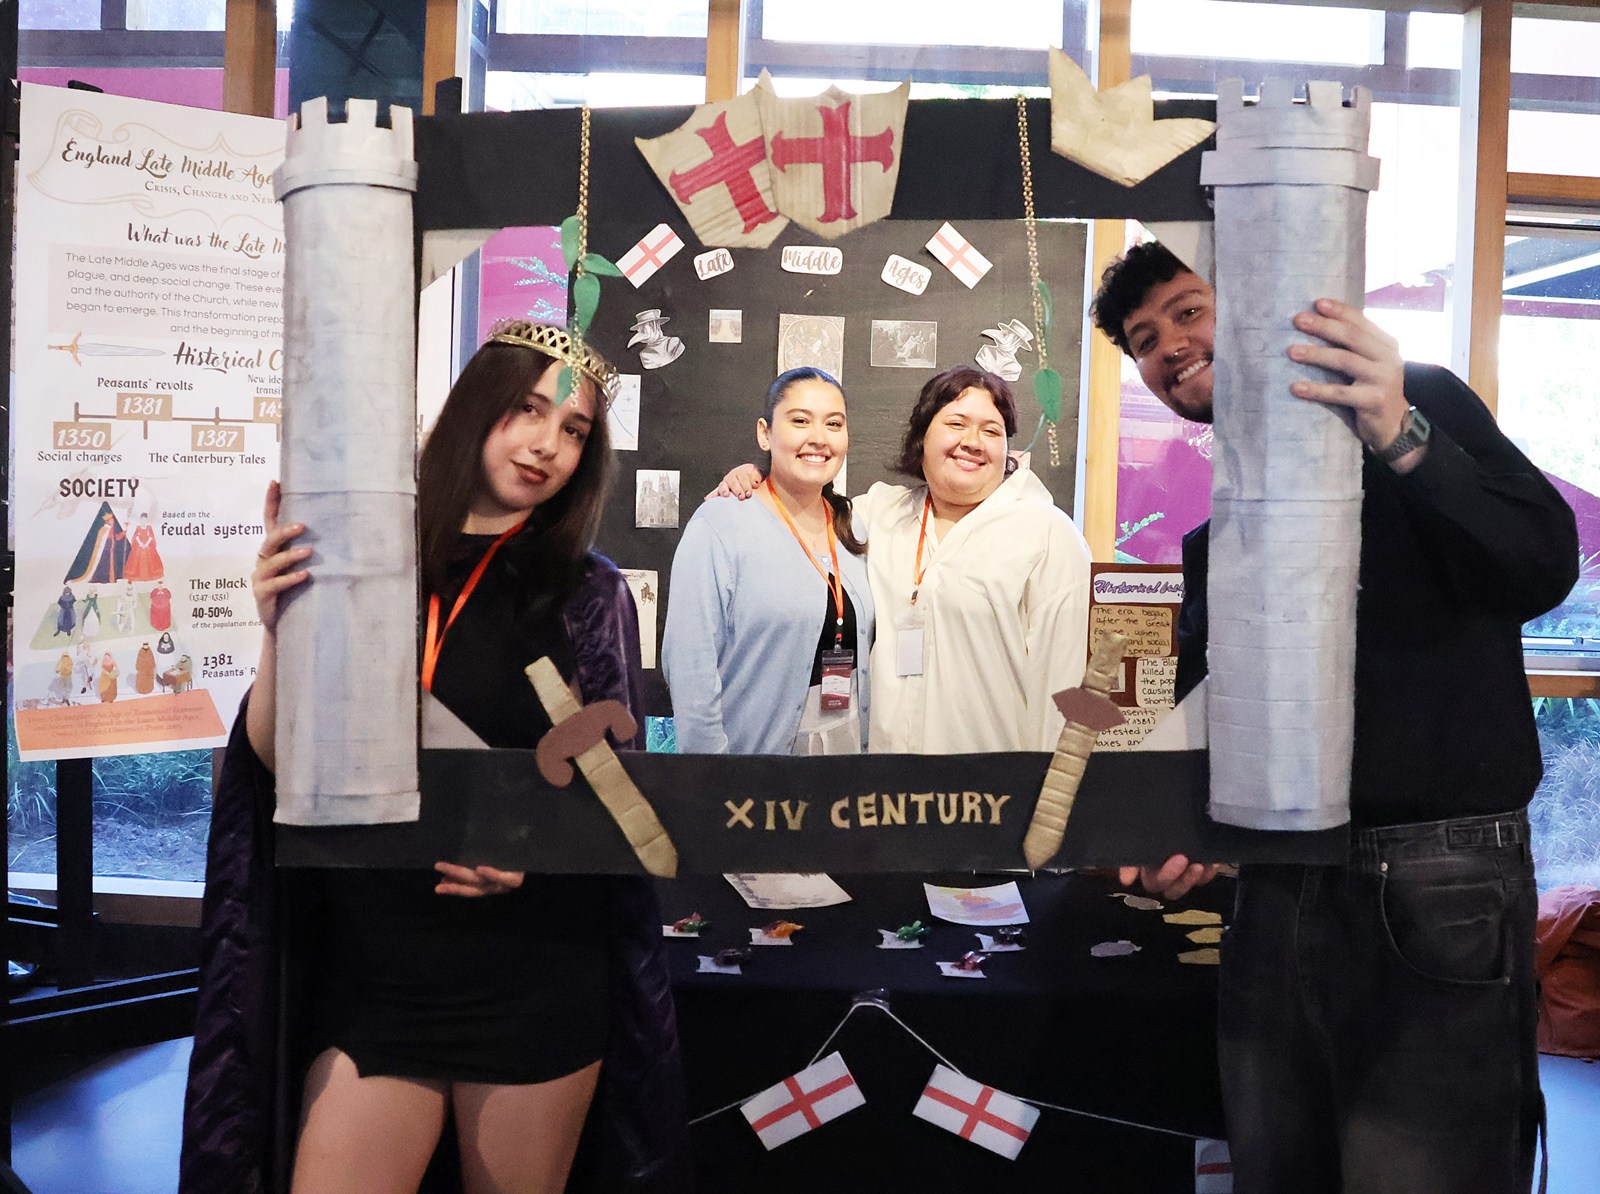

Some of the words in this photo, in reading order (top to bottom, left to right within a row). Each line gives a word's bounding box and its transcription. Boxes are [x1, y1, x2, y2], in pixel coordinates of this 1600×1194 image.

[62, 138, 132, 168] England
[135, 149, 174, 178] Late
[181, 155, 234, 180] Middle
[128, 223, 172, 244] What
[175, 235, 202, 247] was
[208, 232, 230, 250] the
[233, 232, 265, 259] Late
[66, 252, 86, 263] The
[88, 254, 112, 265] Late
[114, 256, 149, 268] Middle
[151, 260, 177, 271] Ages
[179, 263, 200, 272] was
[202, 264, 218, 274] the
[220, 265, 240, 275] final
[242, 268, 269, 279] stage
[270, 271, 280, 279] of
[697, 250, 731, 277] Late
[784, 248, 841, 270] Middle
[67, 269, 108, 281] plague,
[110, 273, 130, 282] and
[132, 275, 159, 285] deep
[161, 277, 191, 287] social
[192, 279, 233, 291] change.
[235, 281, 263, 292] These
[888, 259, 926, 289] Ages
[70, 285, 92, 295] and
[94, 287, 112, 297] the
[113, 289, 159, 301] authority
[161, 292, 172, 301] of
[174, 292, 190, 302] the
[232, 298, 258, 307] while
[66, 301, 101, 313] began
[103, 303, 114, 313] to
[116, 305, 158, 317] emerge.
[161, 307, 182, 317] This
[183, 309, 256, 322] transformation
[170, 324, 190, 333] and
[192, 324, 209, 334] the
[210, 325, 259, 339] beginning
[260, 329, 270, 337] of
[173, 341, 263, 374] Historical
[155, 379, 194, 391] revolts
[247, 374, 266, 384] New
[123, 396, 164, 415] 1381
[57, 428, 106, 448] 1350
[196, 429, 239, 448] 1387
[37, 450, 72, 462] Social
[76, 451, 123, 465] changes
[148, 452, 169, 463] The
[172, 453, 235, 466] Canterbury
[238, 454, 266, 465] Tales
[59, 478, 140, 498] SOCIETY
[162, 511, 186, 519] Based
[198, 511, 211, 519] the
[161, 522, 206, 536] feudal
[213, 523, 263, 539] system
[189, 578, 211, 590] The
[215, 577, 248, 589] Black
[1094, 579, 1161, 594] Historical
[191, 606, 233, 619] 40-50%
[1093, 607, 1113, 615] The
[1141, 608, 1168, 620] began
[212, 621, 247, 629] population
[1096, 616, 1121, 626] after
[1124, 616, 1139, 625] the
[1145, 619, 1170, 628] Great
[1134, 629, 1160, 637] when
[1127, 638, 1144, 646] and
[1147, 638, 1170, 646] social
[1127, 647, 1161, 656] spread
[203, 653, 233, 670] 1381
[1138, 658, 1159, 667] The
[1140, 678, 1157, 686] the
[724, 798, 809, 830] XIV
[830, 790, 1011, 829] CENTURY
